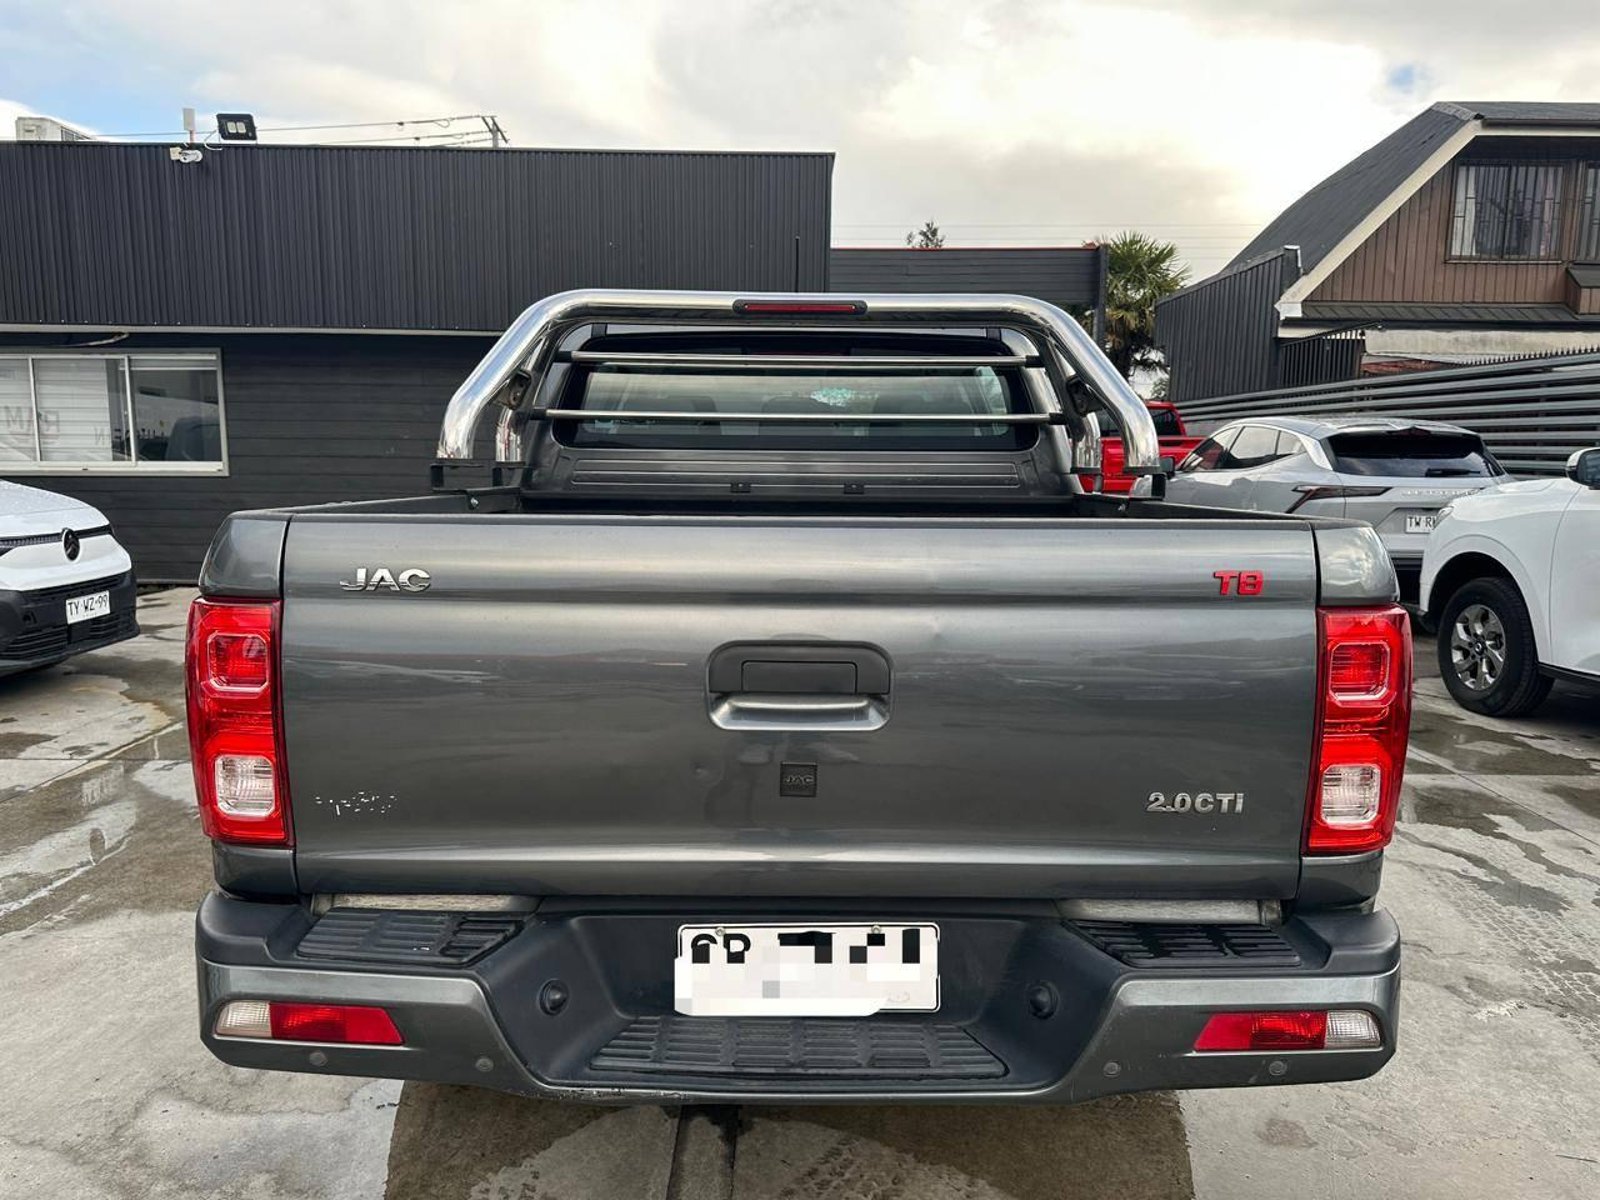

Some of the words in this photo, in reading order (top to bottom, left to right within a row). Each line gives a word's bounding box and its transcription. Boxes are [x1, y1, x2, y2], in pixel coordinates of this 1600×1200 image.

[340, 568, 431, 592] JAC
[1213, 571, 1263, 596] T8
[1147, 791, 1245, 814] 2.0CTI
